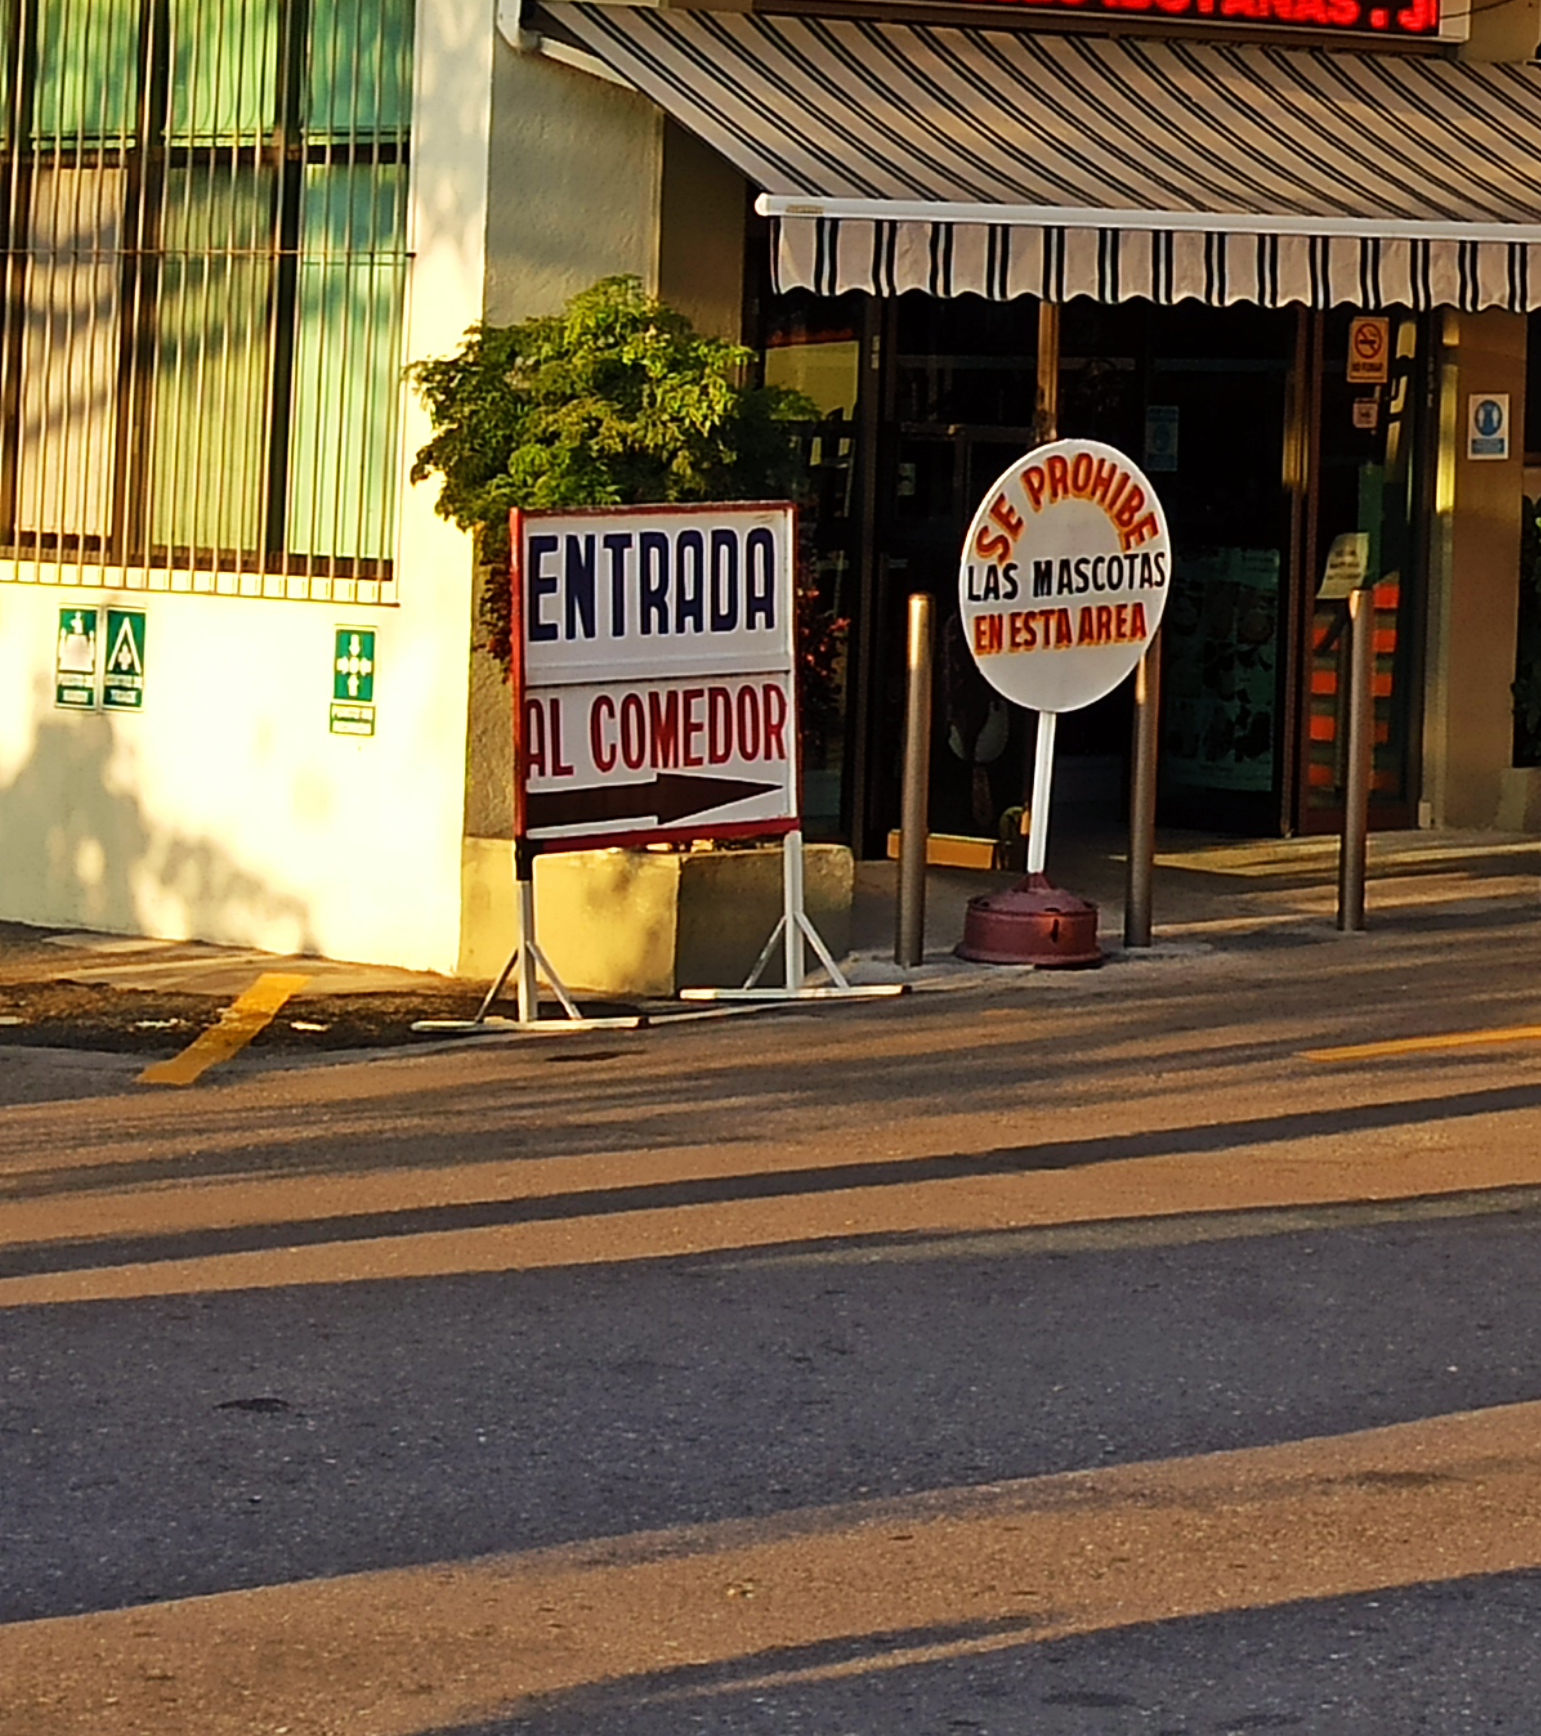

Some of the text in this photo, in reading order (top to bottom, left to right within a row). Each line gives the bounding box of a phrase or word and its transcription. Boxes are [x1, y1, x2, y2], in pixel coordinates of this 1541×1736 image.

[975, 451, 1160, 565] SE PROHIBE
[528, 526, 776, 643] ENTRADA
[967, 551, 1166, 602] LAS MASCOTAS
[973, 602, 1147, 656] EN ESTA AREA
[527, 683, 787, 780] AL COMEDOR
